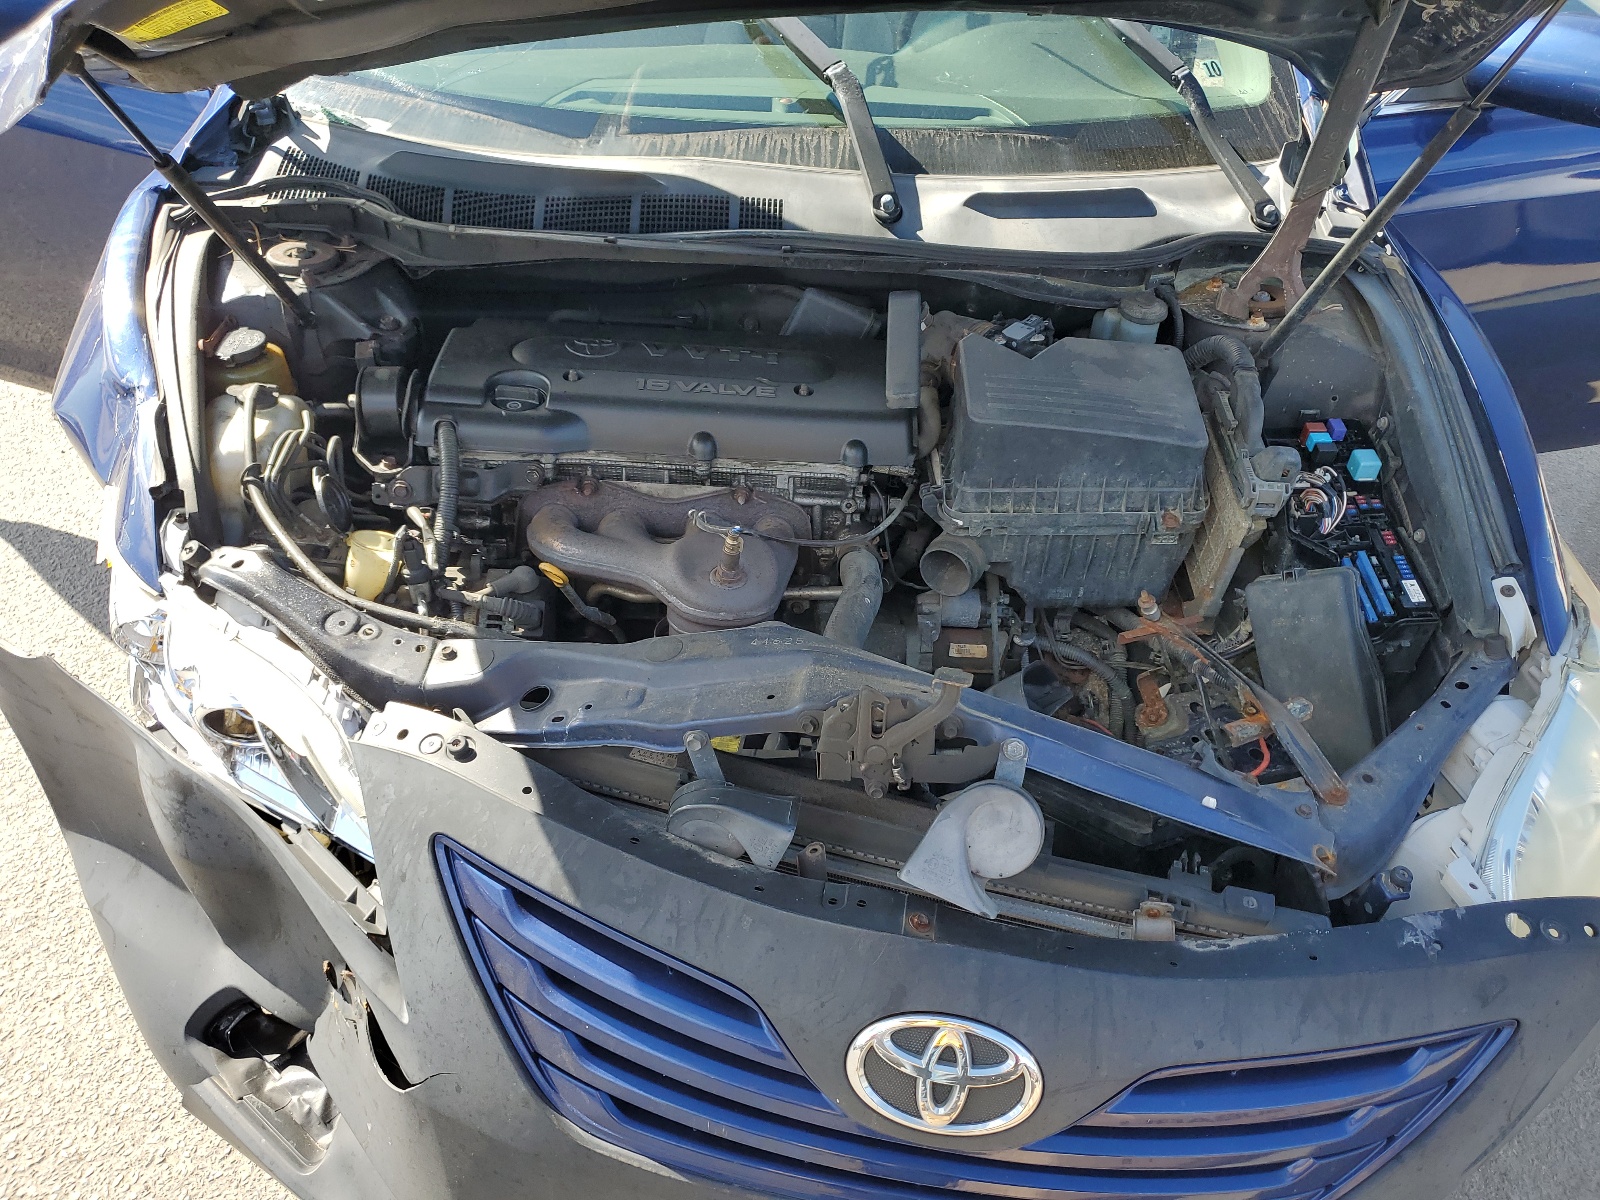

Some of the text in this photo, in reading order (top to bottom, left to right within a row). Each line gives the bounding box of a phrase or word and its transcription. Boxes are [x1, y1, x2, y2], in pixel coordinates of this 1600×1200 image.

[1203, 60, 1221, 77] 10
[635, 377, 777, 398] 16 VALVE
